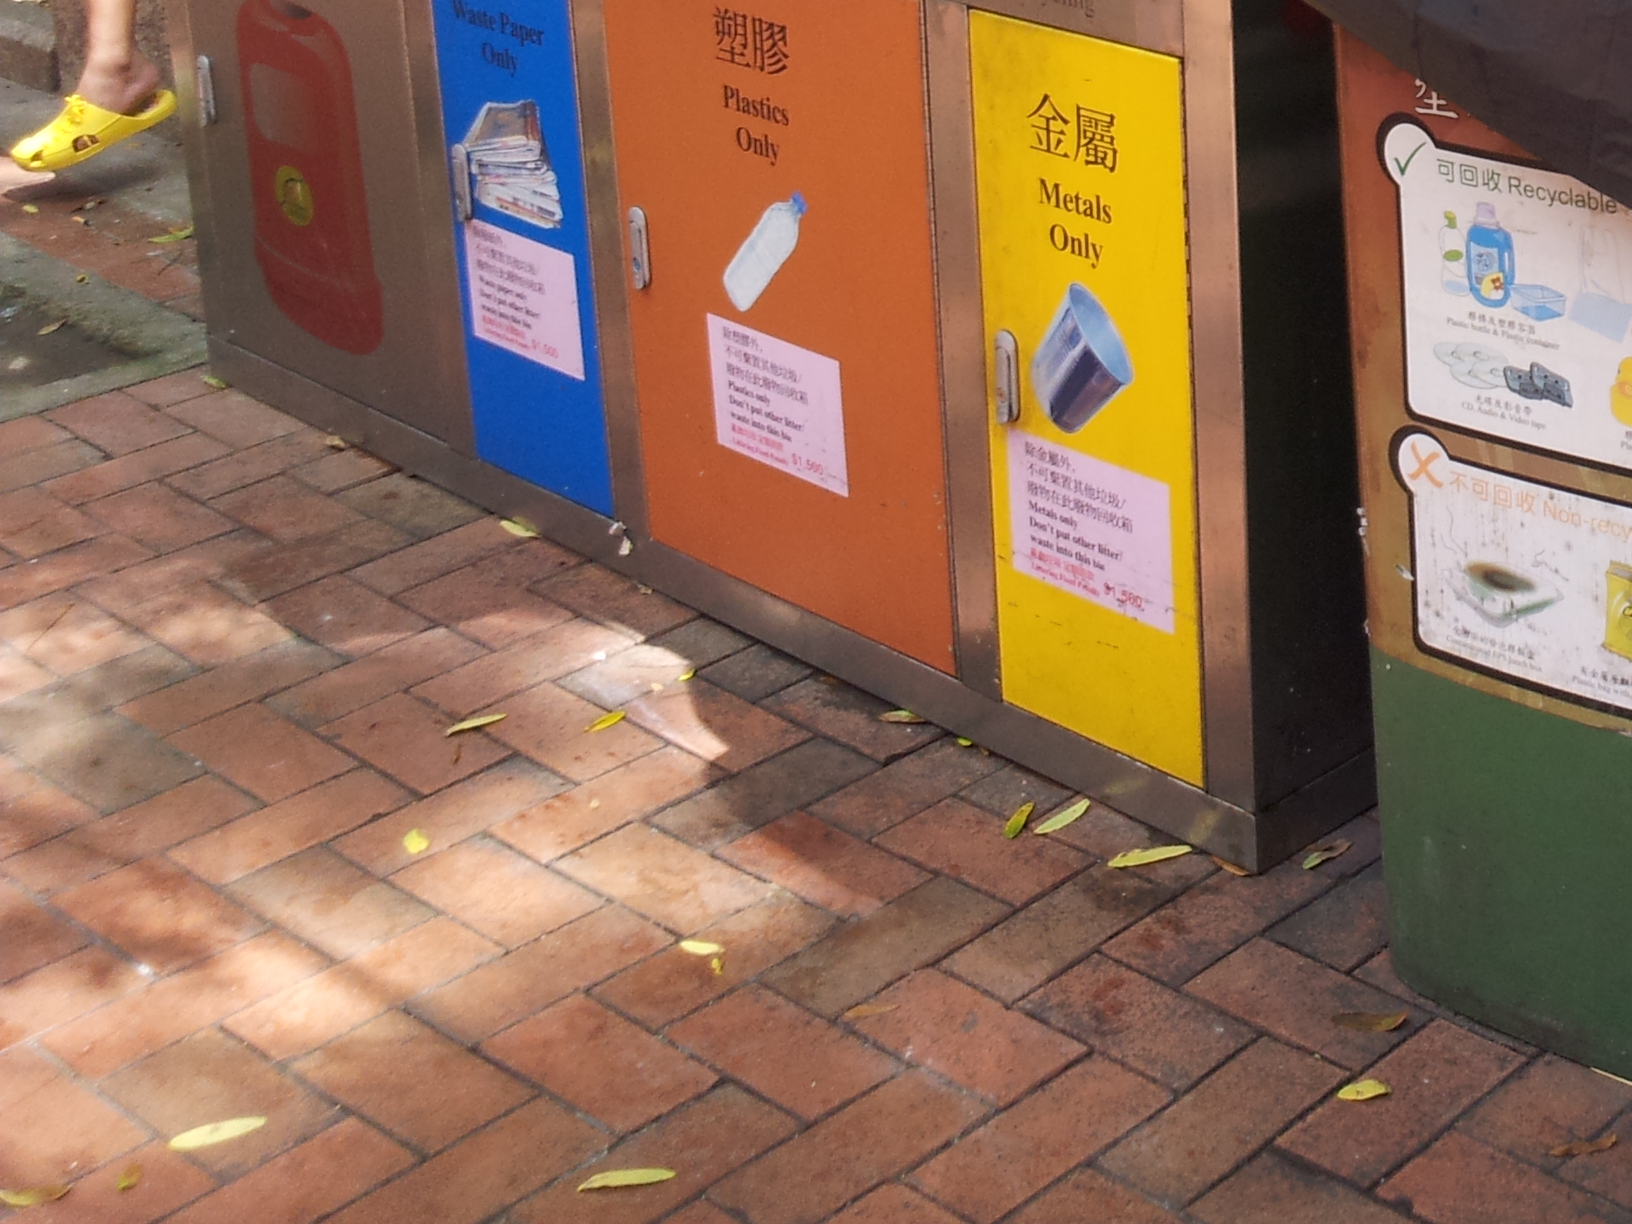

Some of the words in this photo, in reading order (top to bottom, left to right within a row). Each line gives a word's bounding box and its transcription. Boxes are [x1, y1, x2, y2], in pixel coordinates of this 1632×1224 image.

[498, 13, 546, 48] Paper
[712, 5, 791, 76] 塑膠
[481, 42, 520, 77] Only
[722, 83, 791, 127] Plastics
[736, 125, 781, 166] Only
[1026, 91, 1120, 175] 金屬
[1038, 177, 1114, 226] Metals
[1437, 158, 1503, 194] 可回收
[1507, 176, 1619, 216] Recyclable
[1049, 222, 1104, 270] Only
[1028, 500, 1058, 522] Metals
[1059, 513, 1079, 531] only
[1449, 468, 1538, 519] 不可回收
[1029, 516, 1055, 535] Don't
[1056, 526, 1071, 541] put
[1072, 531, 1096, 551] other
[1031, 534, 1054, 552] waste
[1056, 541, 1073, 559] into
[1074, 549, 1091, 567] this
